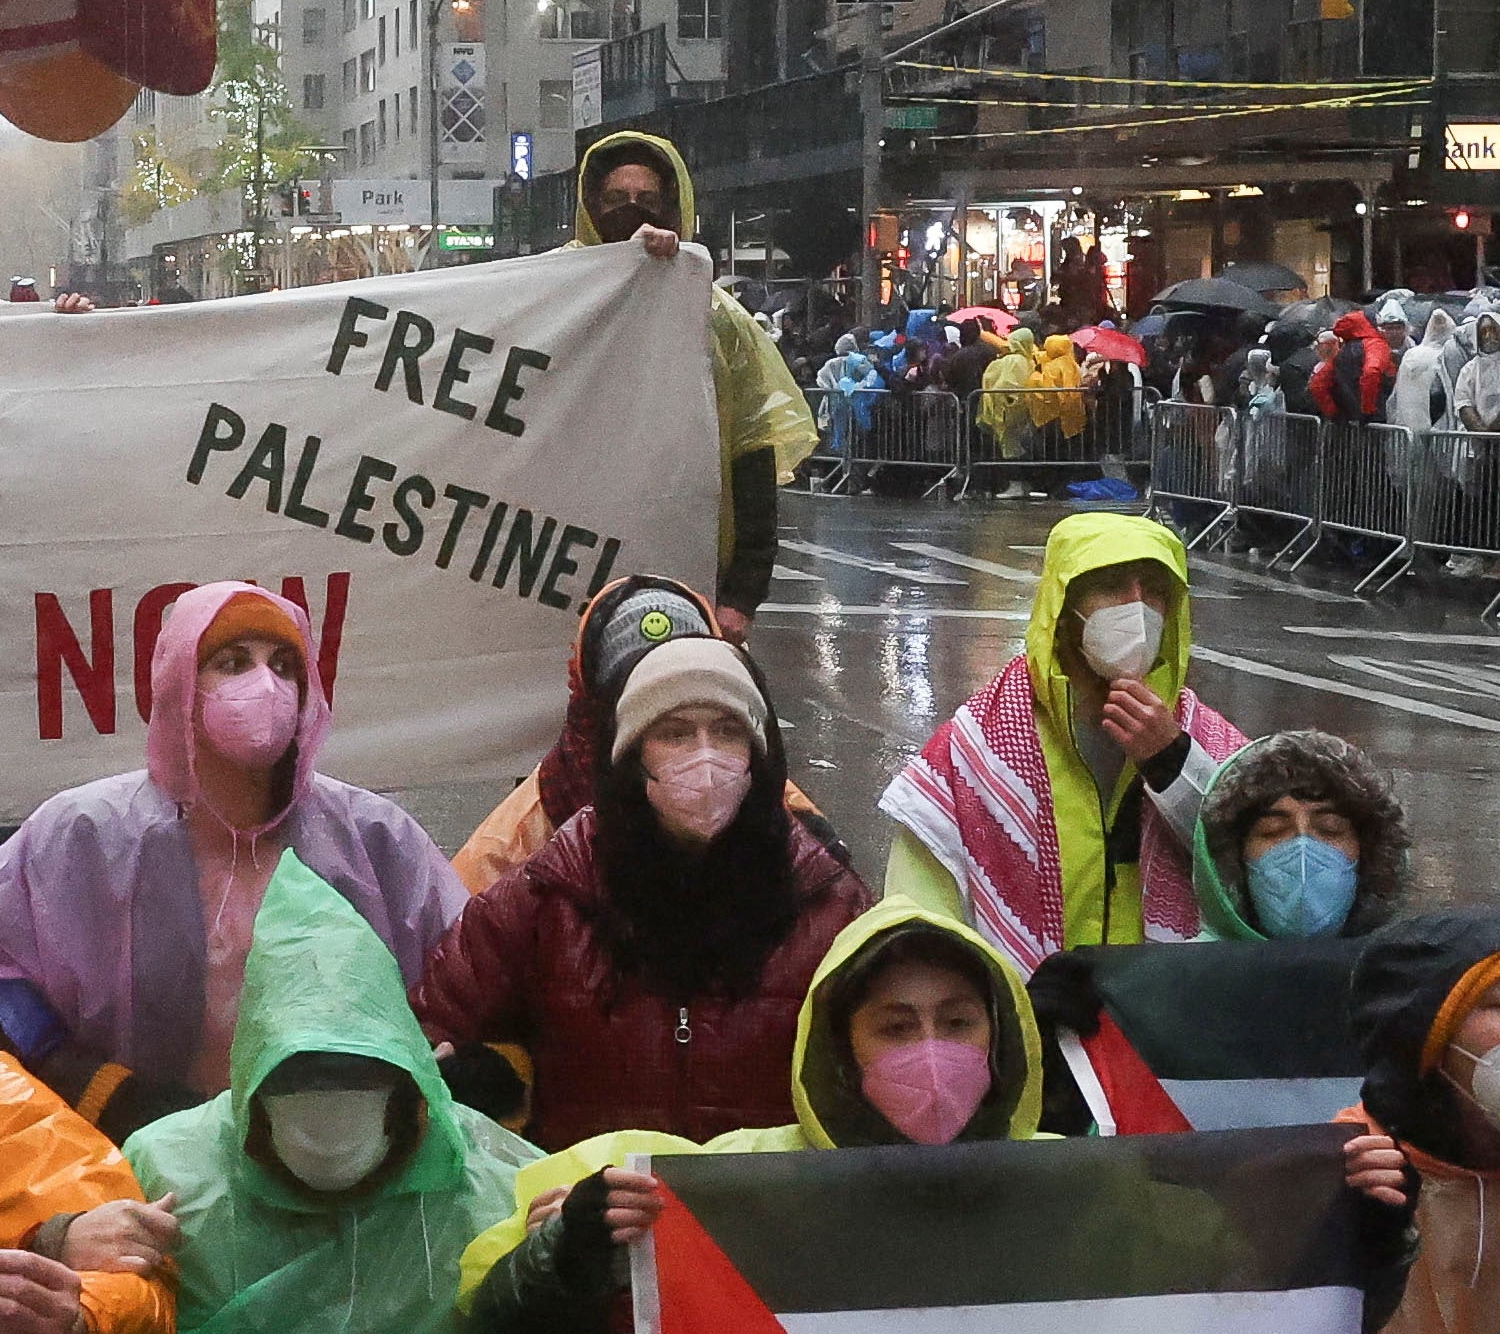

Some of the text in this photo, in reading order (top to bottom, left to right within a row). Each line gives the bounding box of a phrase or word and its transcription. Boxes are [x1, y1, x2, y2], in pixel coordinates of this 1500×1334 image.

[1446, 136, 1497, 159] ank
[362, 190, 403, 205] Park
[326, 296, 552, 437] FREE
[186, 403, 622, 617] PALESTINE!
